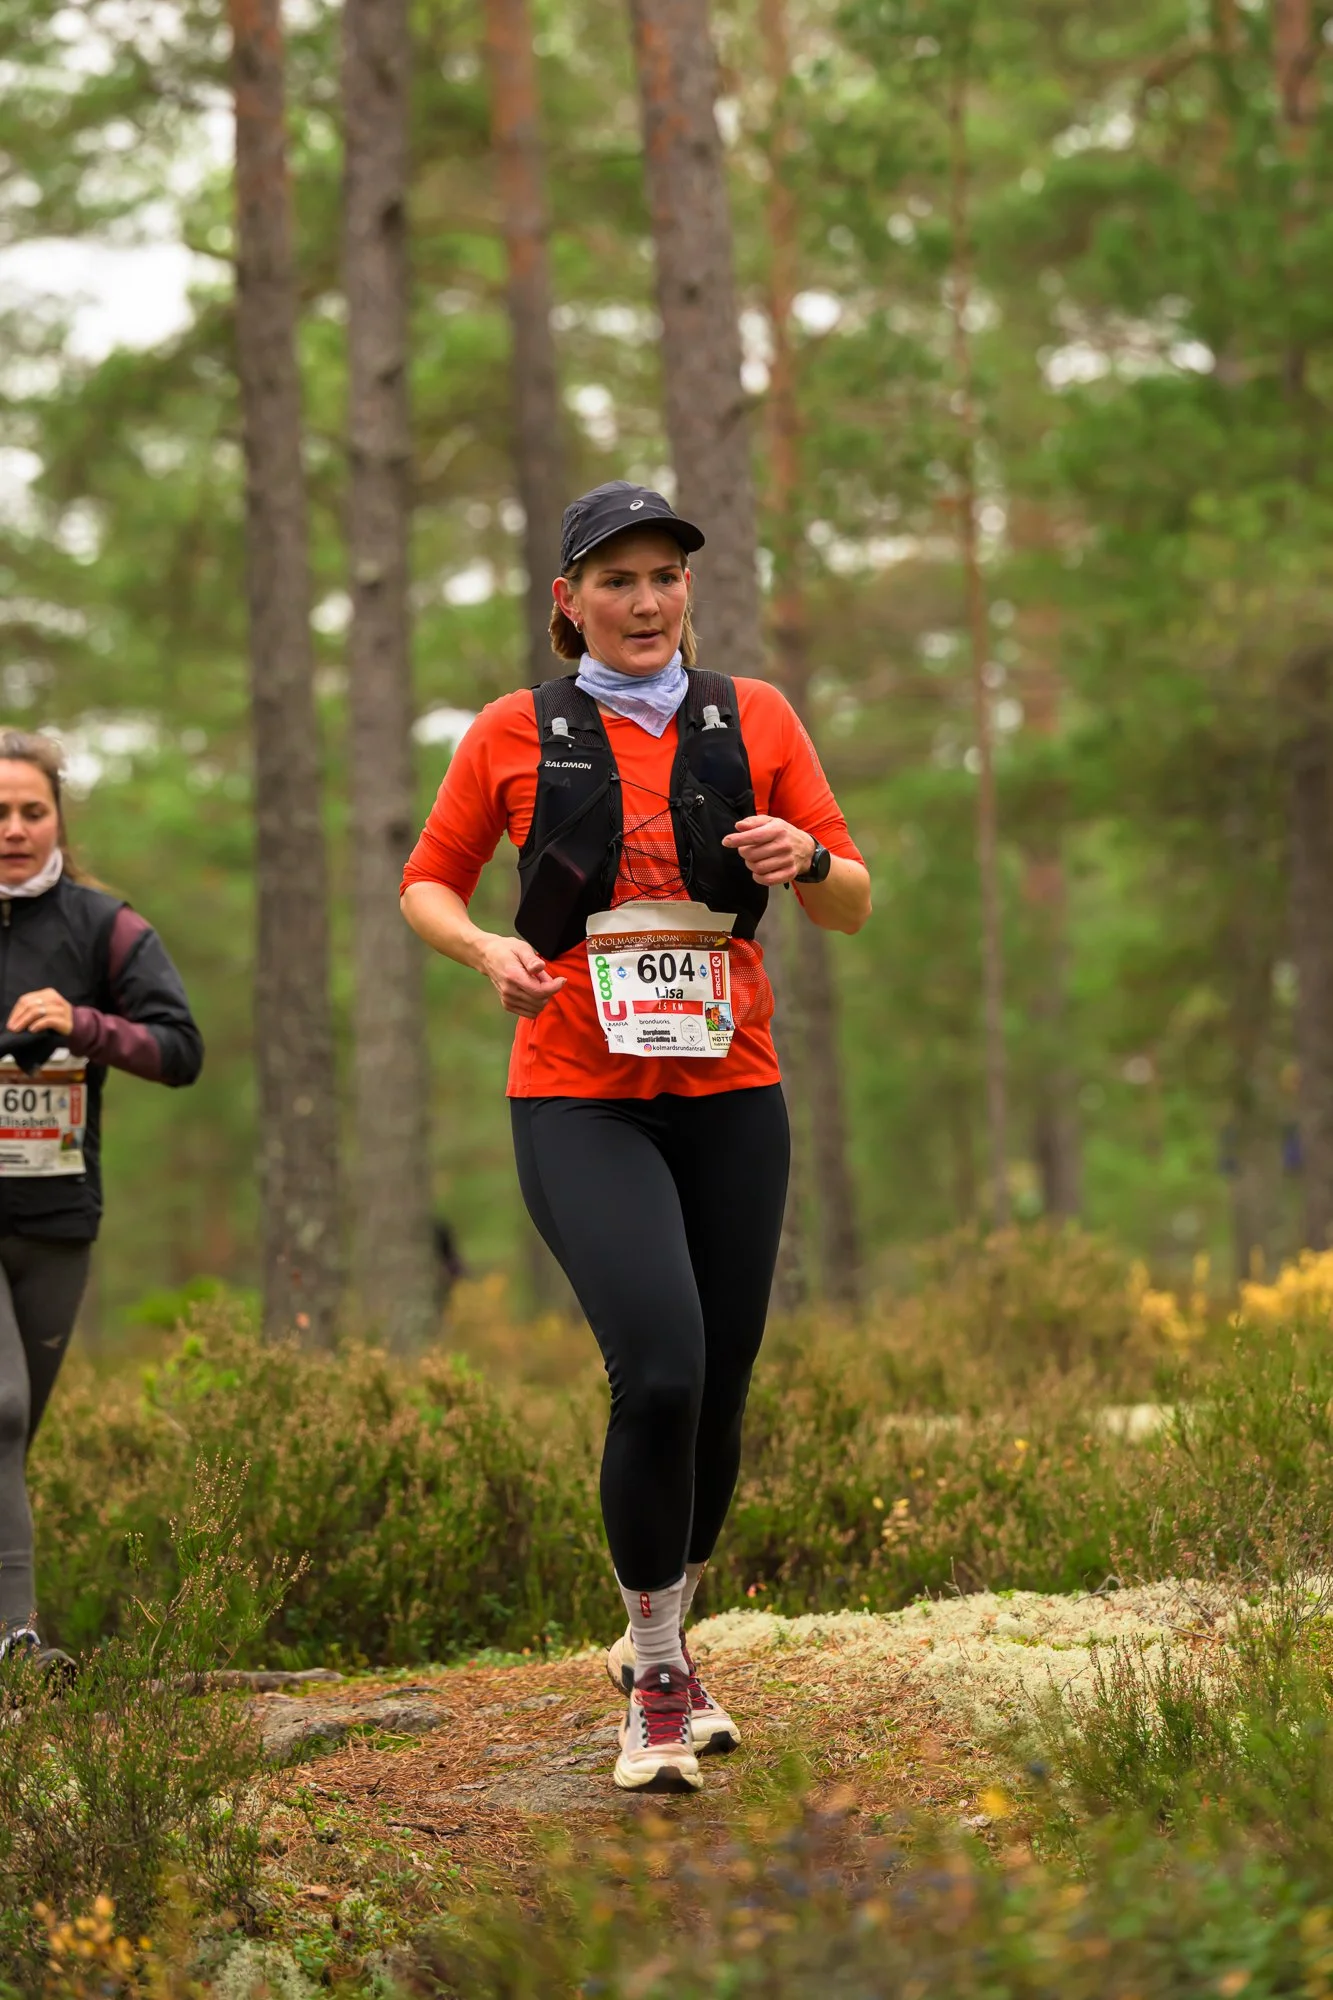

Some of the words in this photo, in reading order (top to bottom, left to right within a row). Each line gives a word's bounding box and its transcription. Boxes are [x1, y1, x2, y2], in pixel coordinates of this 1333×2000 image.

[544, 760, 592, 770] SALOMON
[595, 956, 612, 1000] coop
[637, 953, 696, 984] 604
[655, 986, 684, 999] Lisa
[713, 968, 722, 997] CIRCLE
[658, 1002, 667, 1011] 15
[672, 1002, 684, 1011] KM
[3, 1089, 51, 1113] 601
